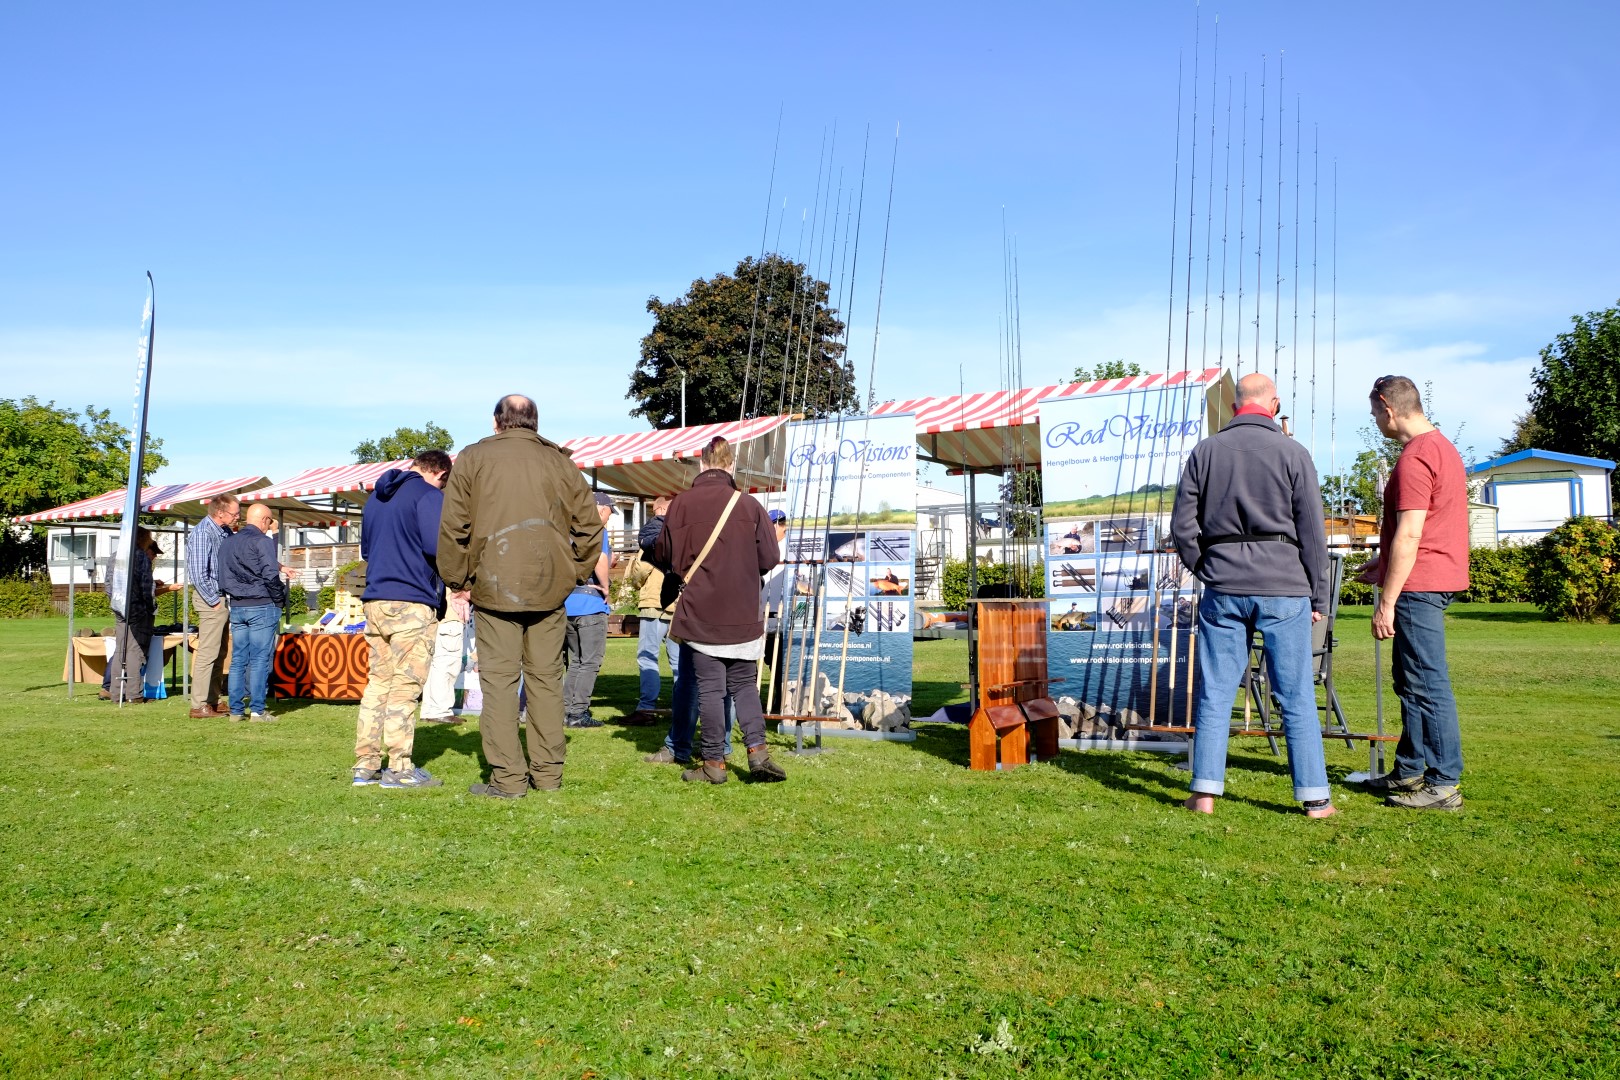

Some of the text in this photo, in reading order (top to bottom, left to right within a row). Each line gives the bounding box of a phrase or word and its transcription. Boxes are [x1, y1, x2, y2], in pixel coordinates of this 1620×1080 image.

[1046, 414, 1202, 448] Rod Visions
[839, 439, 912, 462] Visions
[1047, 458, 1090, 468] Hengelbouw
[1100, 452, 1146, 462] Hengelbouw
[867, 471, 912, 480] Componenten
[1092, 641, 1161, 650] www.rodvisions.l
